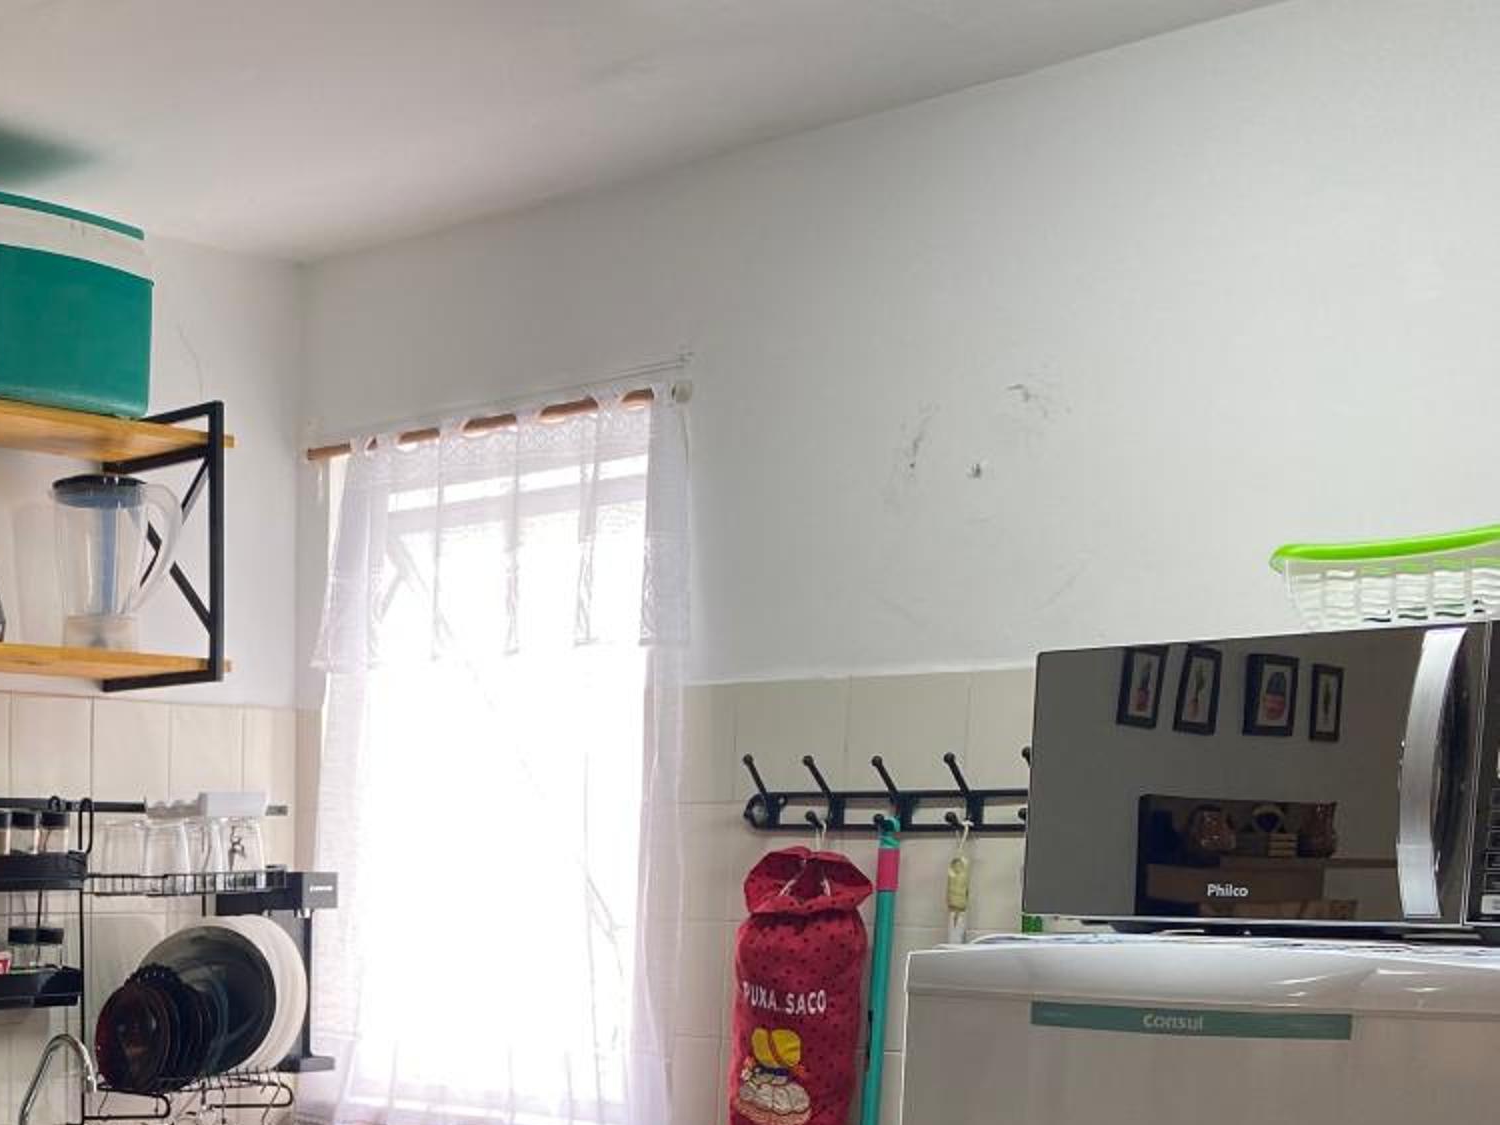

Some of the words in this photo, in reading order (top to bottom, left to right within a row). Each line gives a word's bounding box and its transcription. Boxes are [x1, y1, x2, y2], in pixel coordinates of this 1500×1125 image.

[1206, 883, 1249, 897] Philco
[741, 979, 777, 1008] PUXA
[786, 988, 827, 1014] SACO
[1141, 1012, 1204, 1032] Consul
